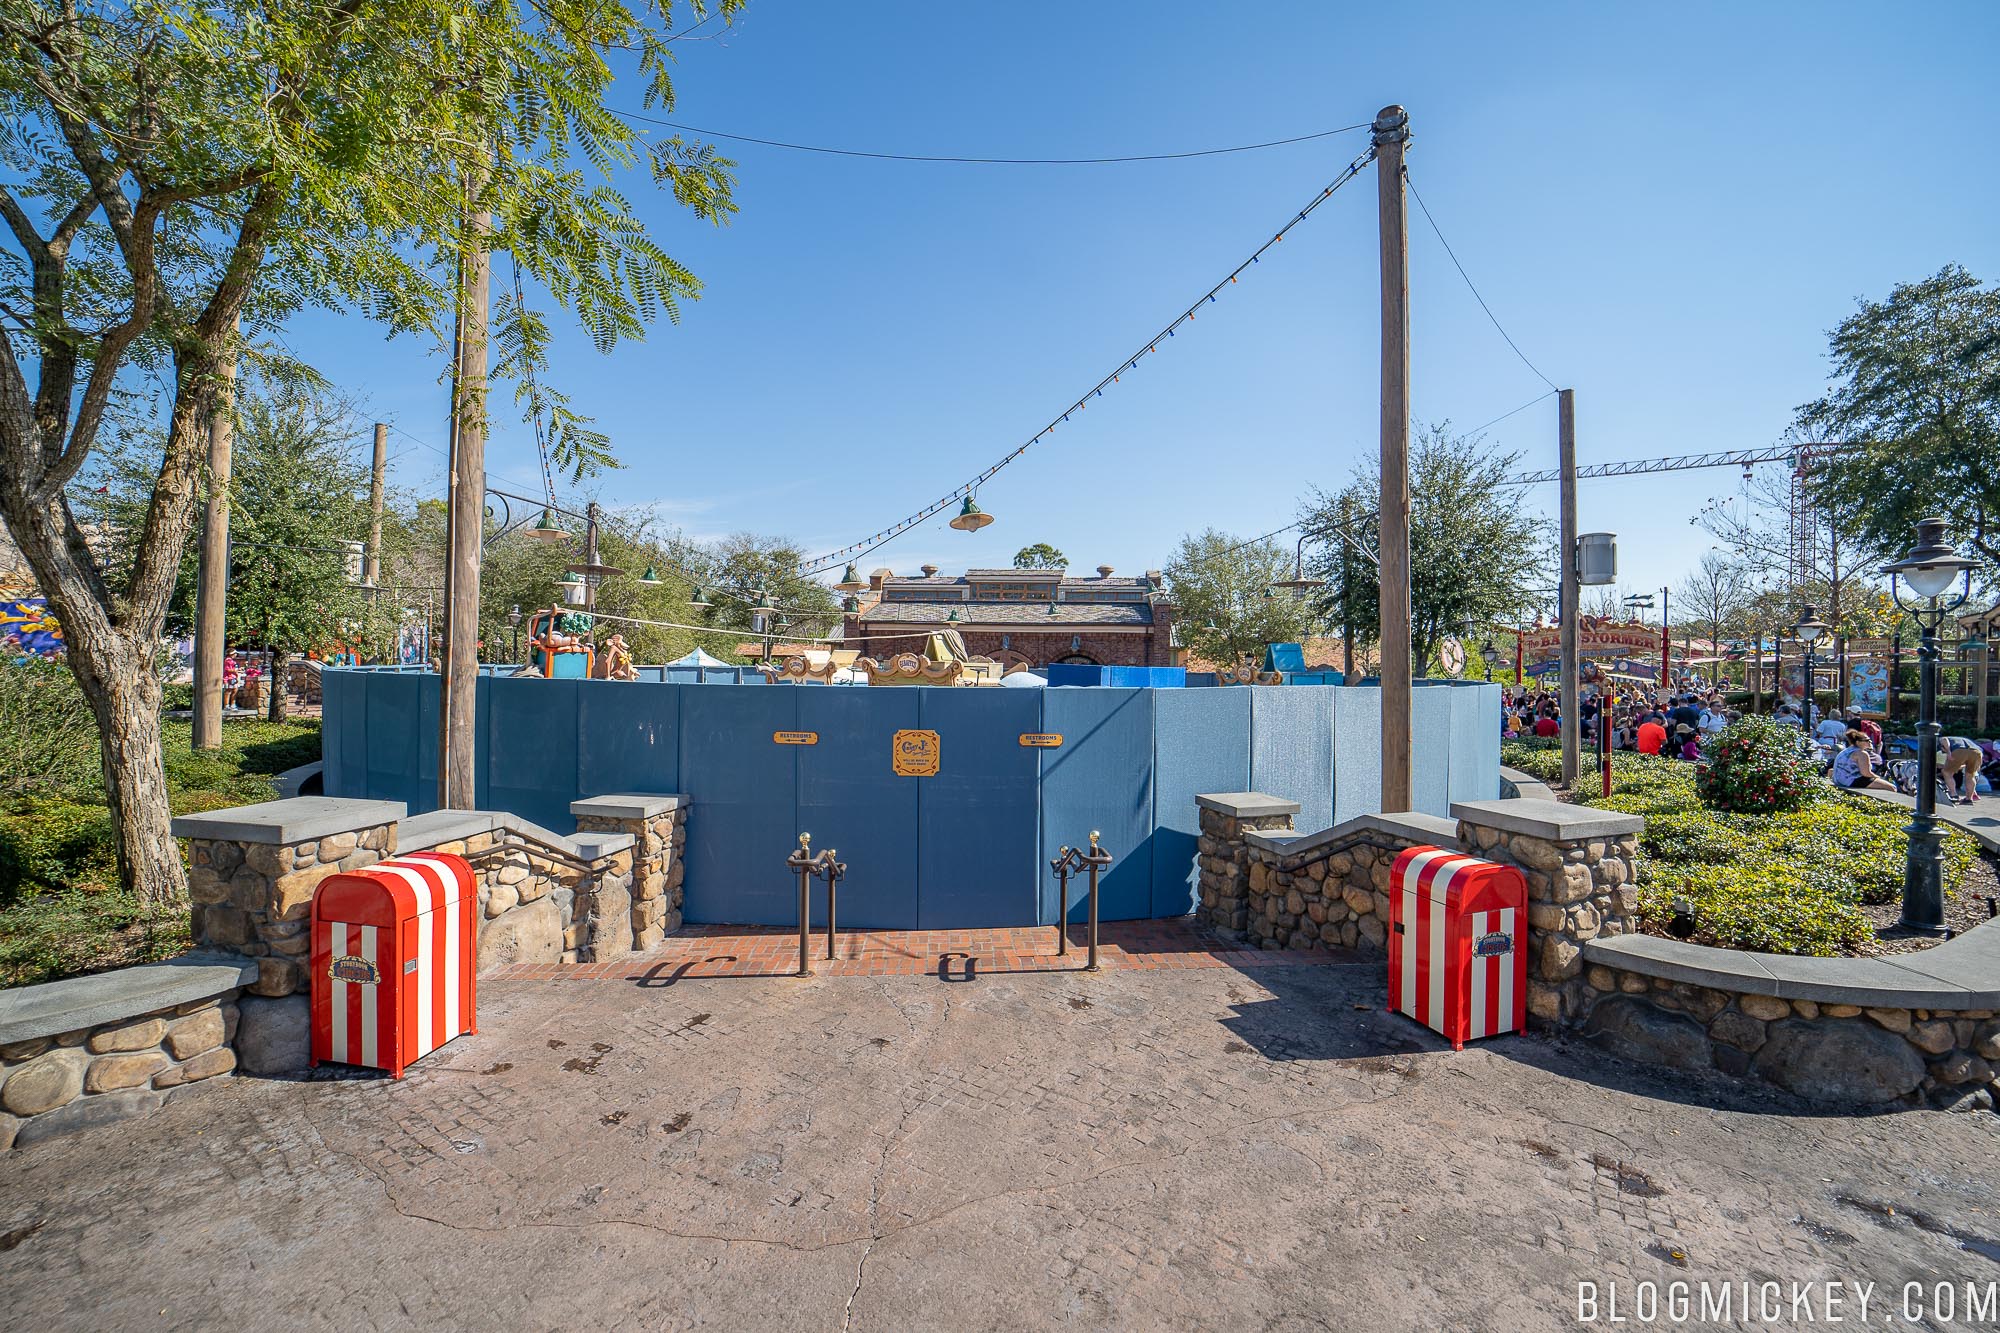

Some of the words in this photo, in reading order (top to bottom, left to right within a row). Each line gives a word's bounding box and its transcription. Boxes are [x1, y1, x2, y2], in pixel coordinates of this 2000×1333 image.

[1526, 640, 1539, 649] The
[1541, 633, 1656, 649] BASTORMER
[1482, 943, 1507, 953] CIRCUS
[337, 967, 370, 980] CIRCUS
